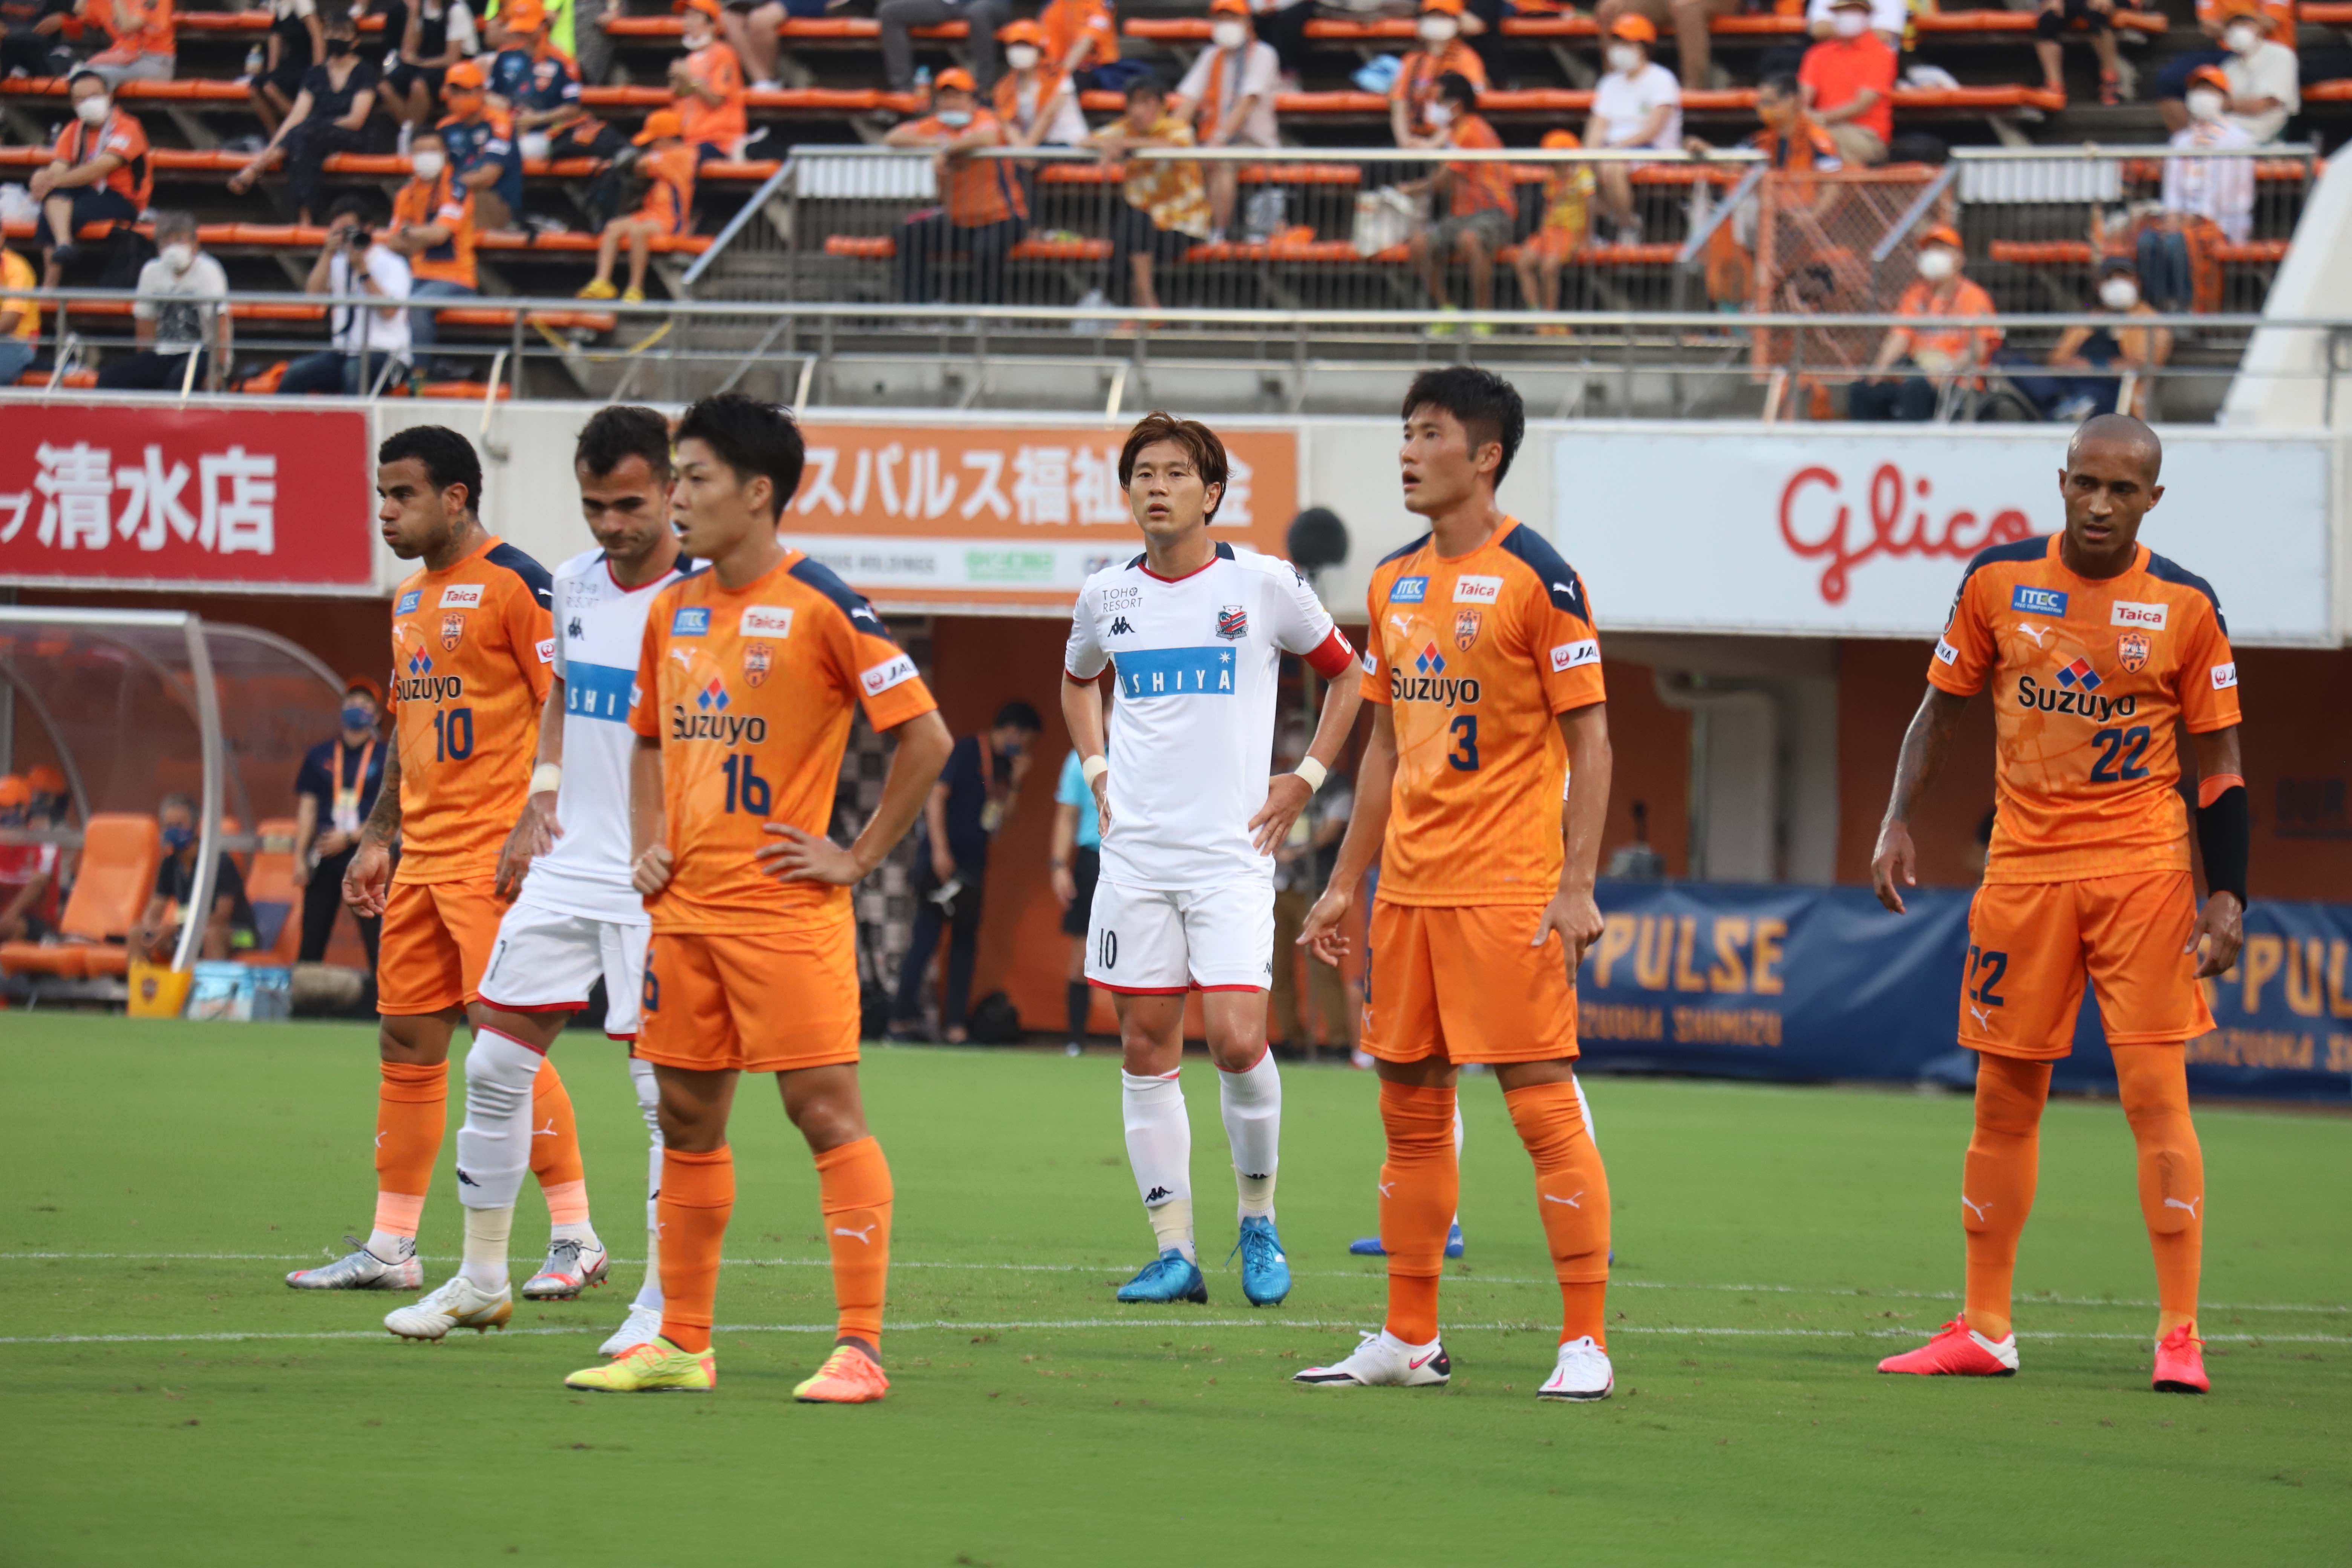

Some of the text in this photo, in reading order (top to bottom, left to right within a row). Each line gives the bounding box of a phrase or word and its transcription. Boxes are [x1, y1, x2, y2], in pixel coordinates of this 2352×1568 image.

[785, 442, 1253, 526] スパルス福祉金
[1779, 462, 2039, 604] Glico
[446, 590, 478, 602] Taica
[1103, 597, 1143, 614] RESORT
[1397, 580, 1424, 594] ITEC
[1461, 582, 1495, 597] Taica
[2021, 589, 2059, 608] ITEC
[746, 614, 786, 631] Taica
[2117, 607, 2162, 623] Taica
[1120, 669, 1231, 694] ISHIYA
[1392, 667, 1480, 709] Suzuyo
[2017, 675, 2137, 723] Suzuyo
[434, 707, 474, 763] 10
[672, 704, 767, 747] Suzuyo
[1448, 715, 1479, 771] 3
[2090, 725, 2151, 782] 22
[722, 754, 771, 816] 16
[1099, 928, 1117, 969] 10
